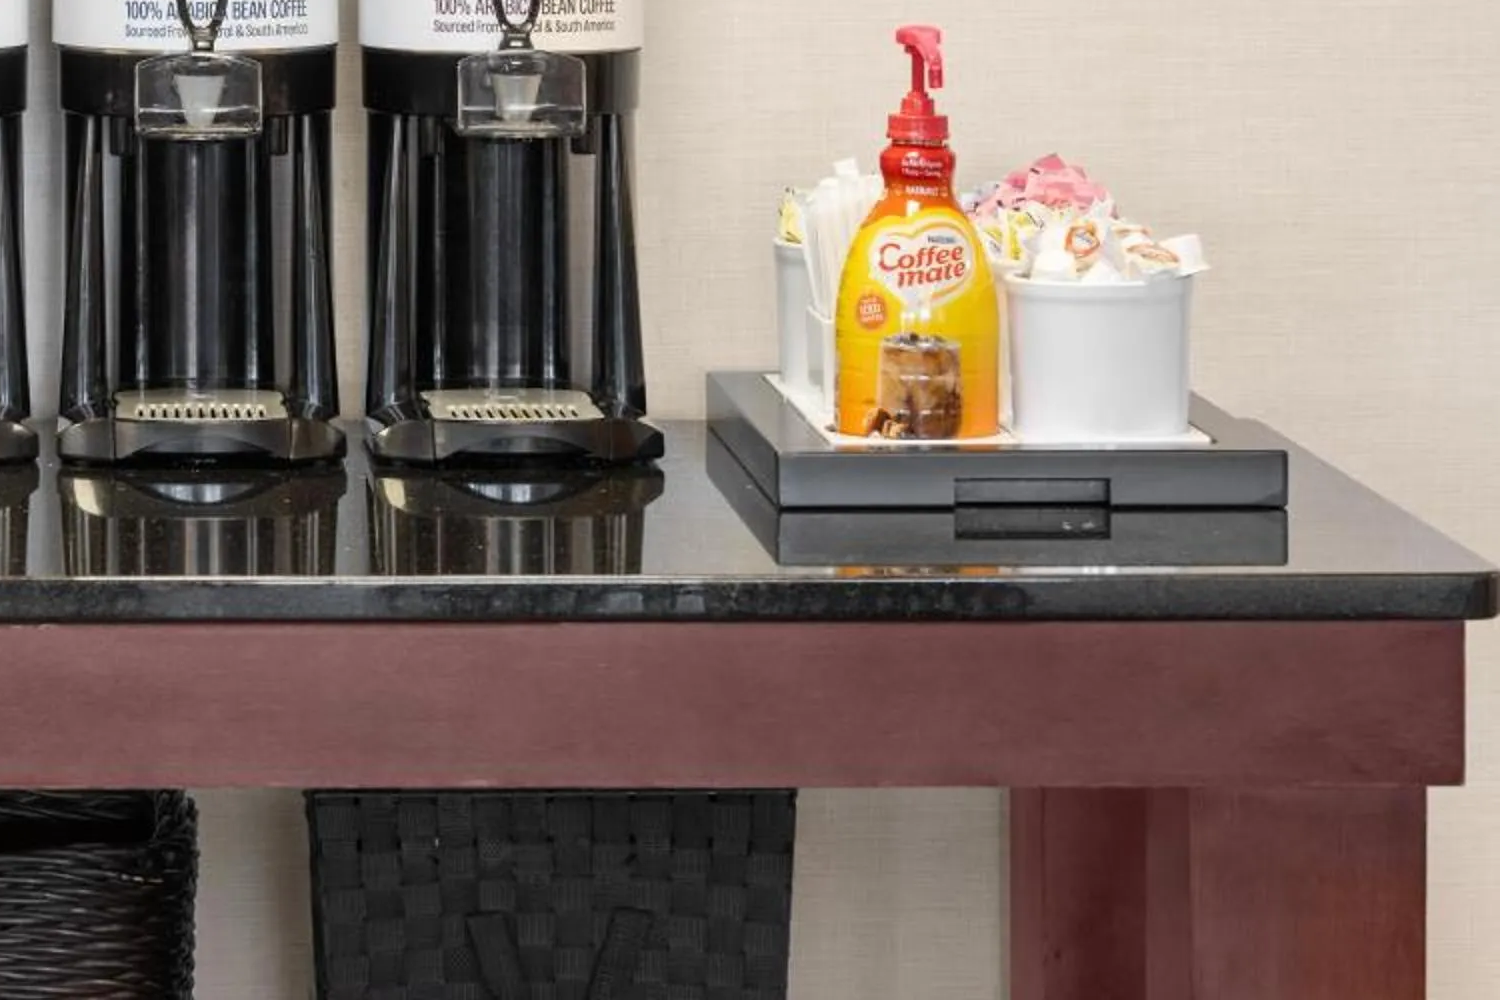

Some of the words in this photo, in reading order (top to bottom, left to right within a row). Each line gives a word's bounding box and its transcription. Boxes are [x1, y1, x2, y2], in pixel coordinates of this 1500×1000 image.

[125, 0, 163, 21] 100%
[232, 0, 267, 20] BEAN
[246, 24, 274, 38] South
[433, 19, 475, 33] Sourced
[555, 19, 582, 34] South
[878, 243, 965, 272] Coffee
[896, 261, 967, 289] mate
